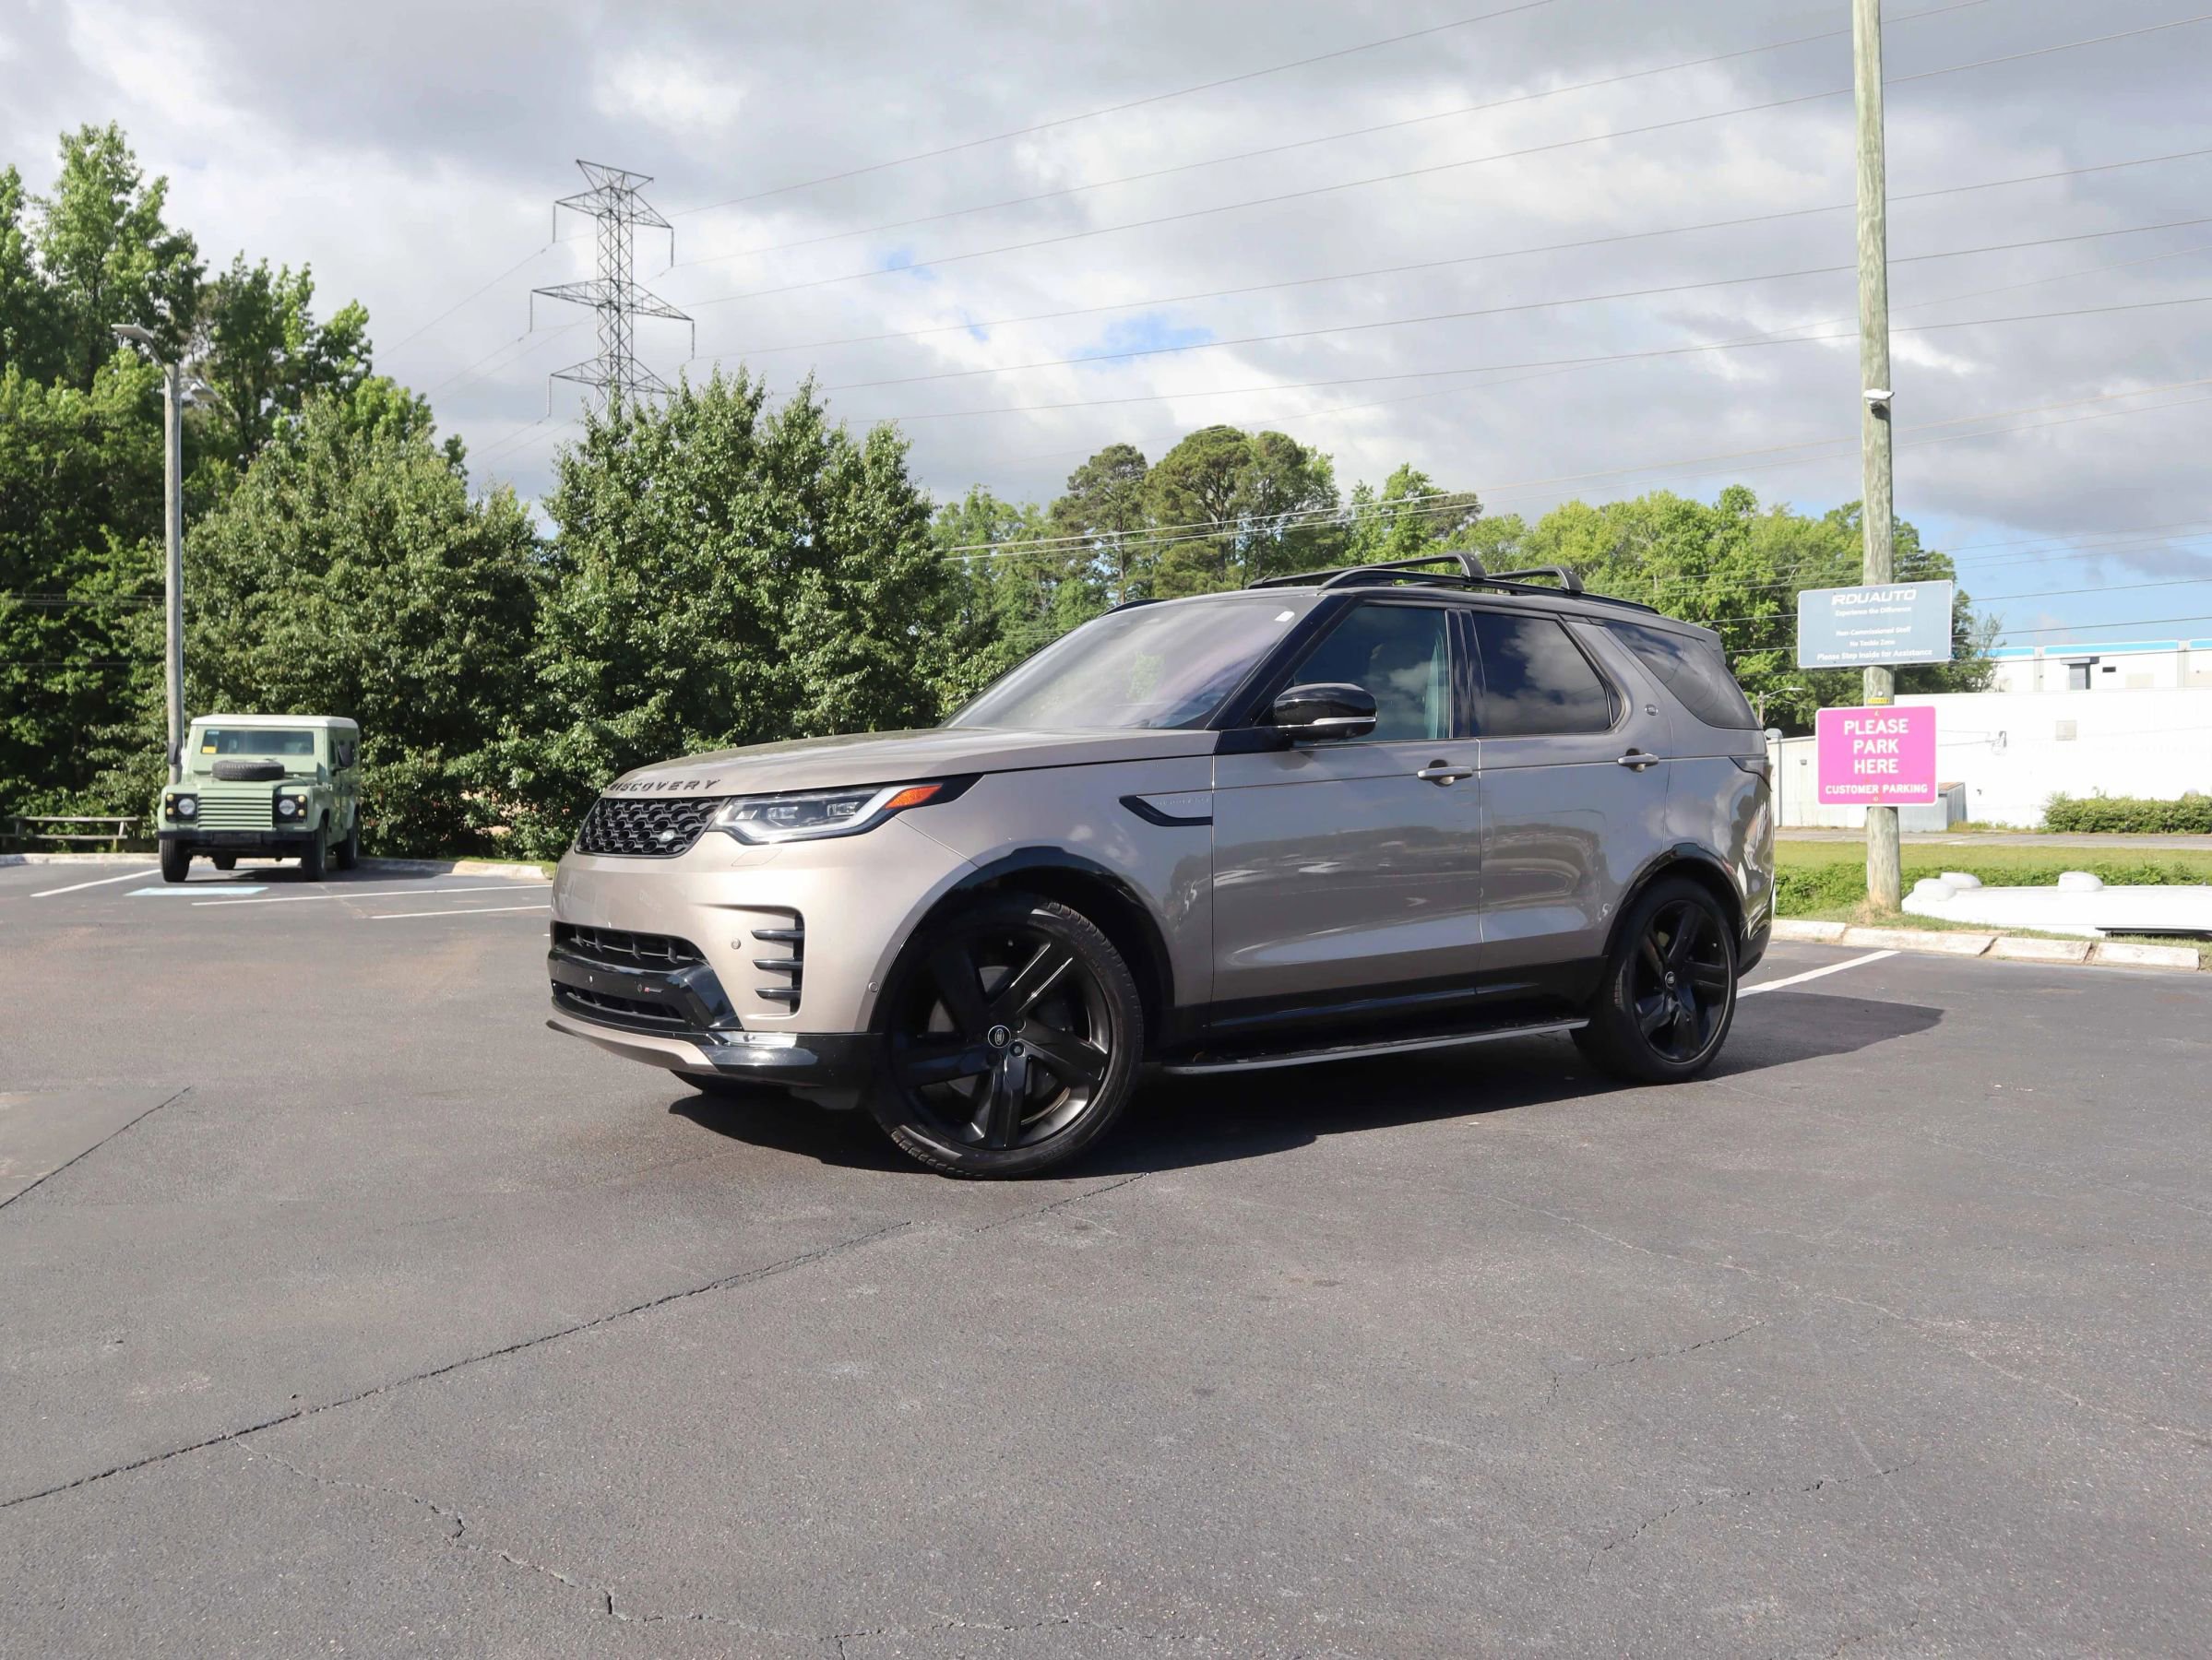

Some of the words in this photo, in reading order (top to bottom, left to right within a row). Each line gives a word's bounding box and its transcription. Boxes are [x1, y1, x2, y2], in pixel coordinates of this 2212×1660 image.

[1841, 652, 1858, 660] Step
[1859, 650, 1880, 658] Inside
[1881, 649, 1892, 658] for
[1893, 648, 1933, 657] Assistance
[1844, 718, 1909, 735] PLEASE
[1853, 739, 1899, 754] PARK
[1854, 758, 1899, 775] HERE
[609, 778, 721, 792] DISCOVERY
[1825, 784, 1879, 795] CUSTOMER
[1882, 783, 1928, 794] PARKING
